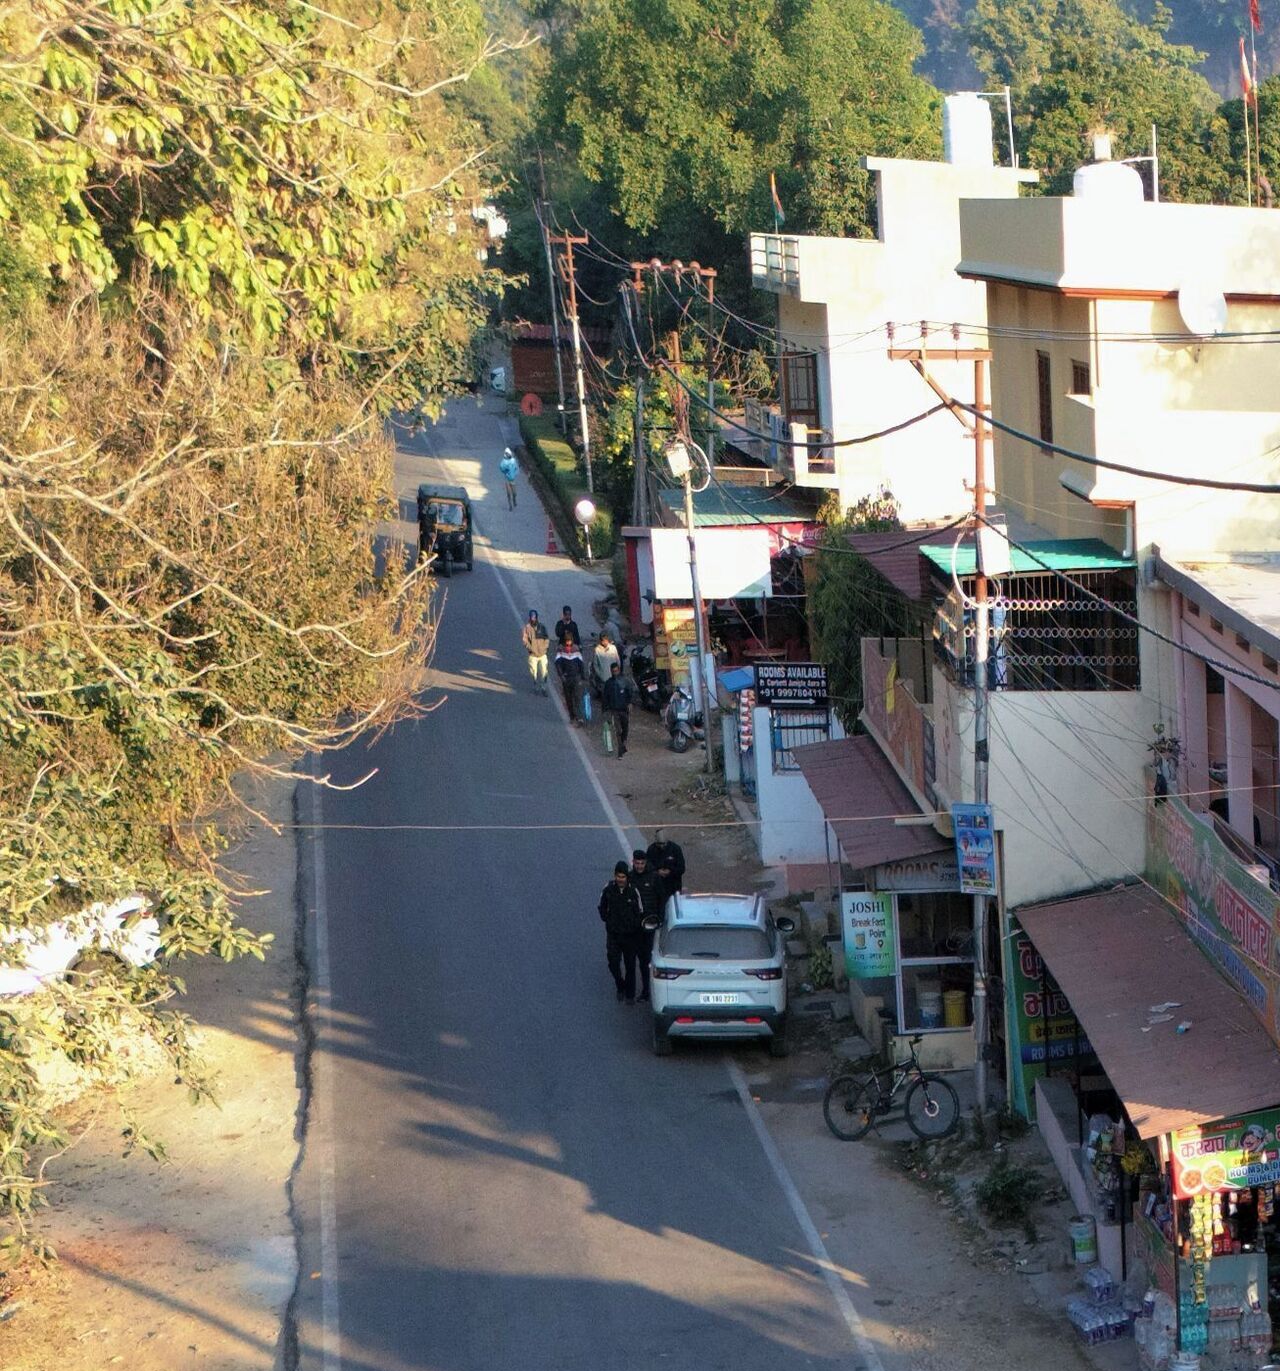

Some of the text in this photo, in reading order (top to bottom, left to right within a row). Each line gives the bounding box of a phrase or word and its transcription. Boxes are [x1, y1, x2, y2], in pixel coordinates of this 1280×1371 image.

[758, 666, 827, 678] ROOMS AVAILABLE
[760, 688, 775, 697] +91
[849, 901, 885, 914] JOSHI
[1230, 1165, 1262, 1178] ROOMS
